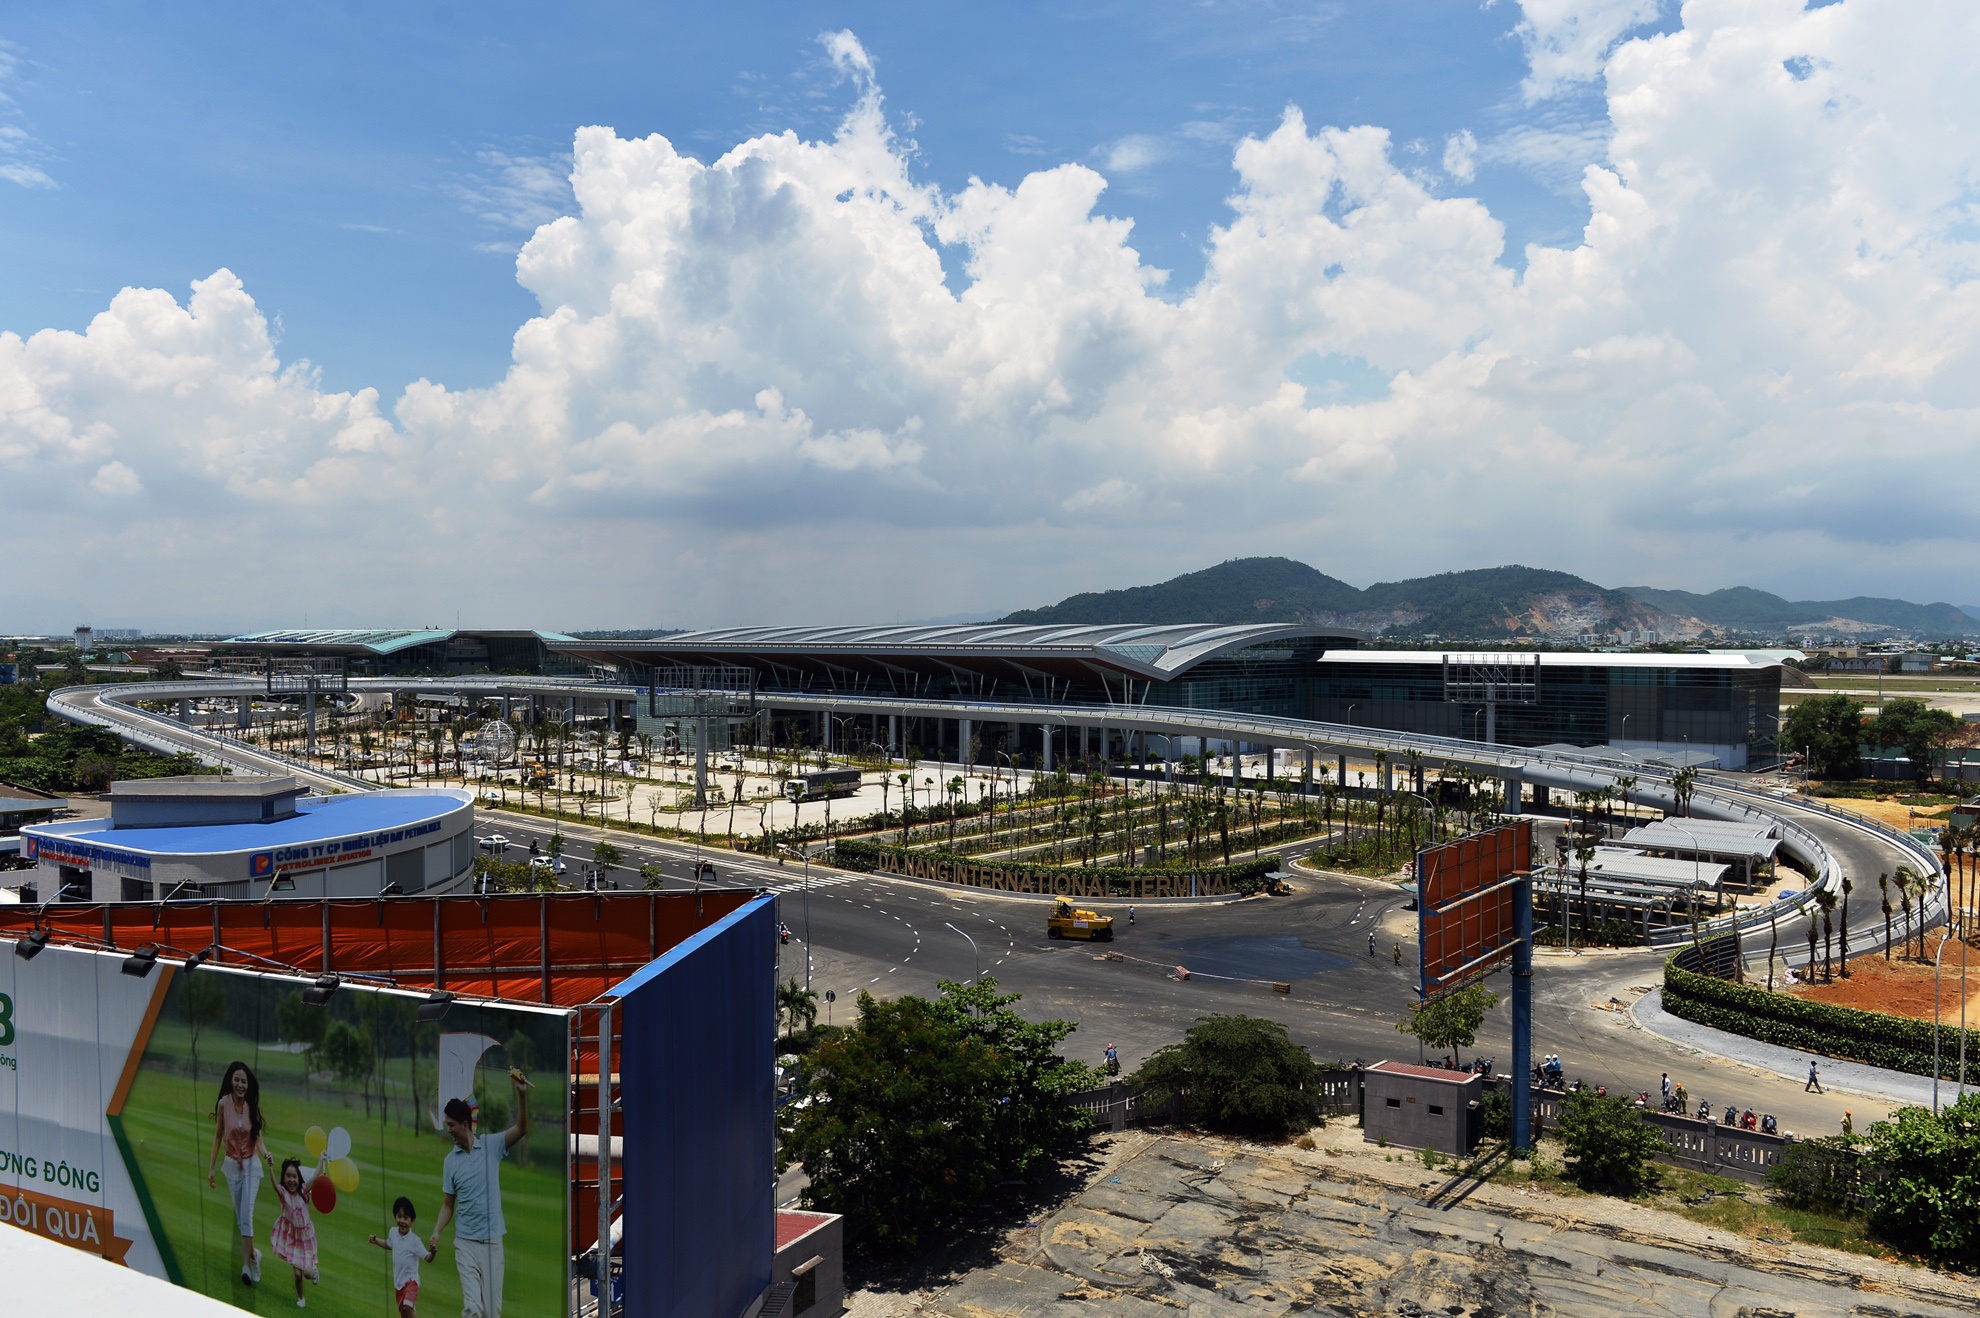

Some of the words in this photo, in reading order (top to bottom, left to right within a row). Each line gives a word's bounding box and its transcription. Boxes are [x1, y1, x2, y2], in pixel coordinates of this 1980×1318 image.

[275, 847, 309, 862] CÔNG
[311, 845, 325, 857] TY
[327, 843, 341, 855] CP
[878, 852, 900, 874] DA
[904, 855, 949, 882] NANG
[953, 863, 1118, 897] INTERNATIONAL
[1125, 873, 1237, 898] TERMINAL
[43, 1160, 100, 1193] ĐÔNG
[0, 1193, 37, 1229] ĐỔI
[45, 1207, 100, 1245] QUÀ
